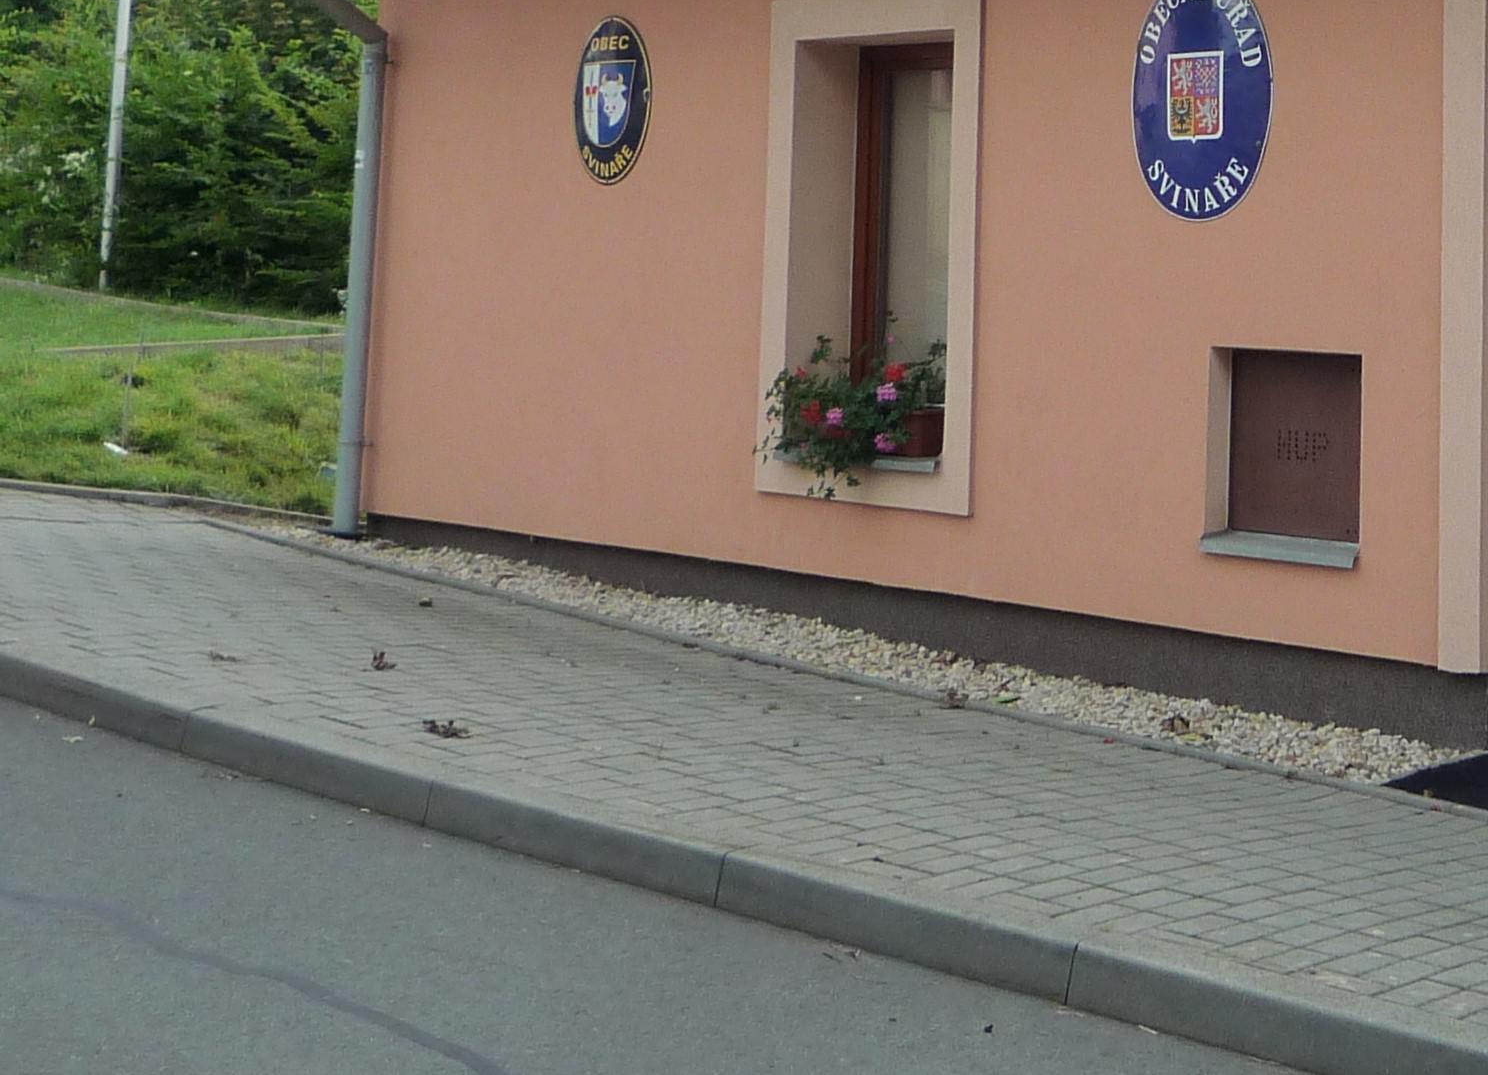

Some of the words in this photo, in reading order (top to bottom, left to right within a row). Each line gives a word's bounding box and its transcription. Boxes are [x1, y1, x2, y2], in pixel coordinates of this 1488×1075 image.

[590, 34, 630, 52] OBEC
[581, 142, 634, 179] SVINAŘE
[1147, 157, 1249, 215] SVINAŘE
[1277, 428, 1330, 463] HUP
